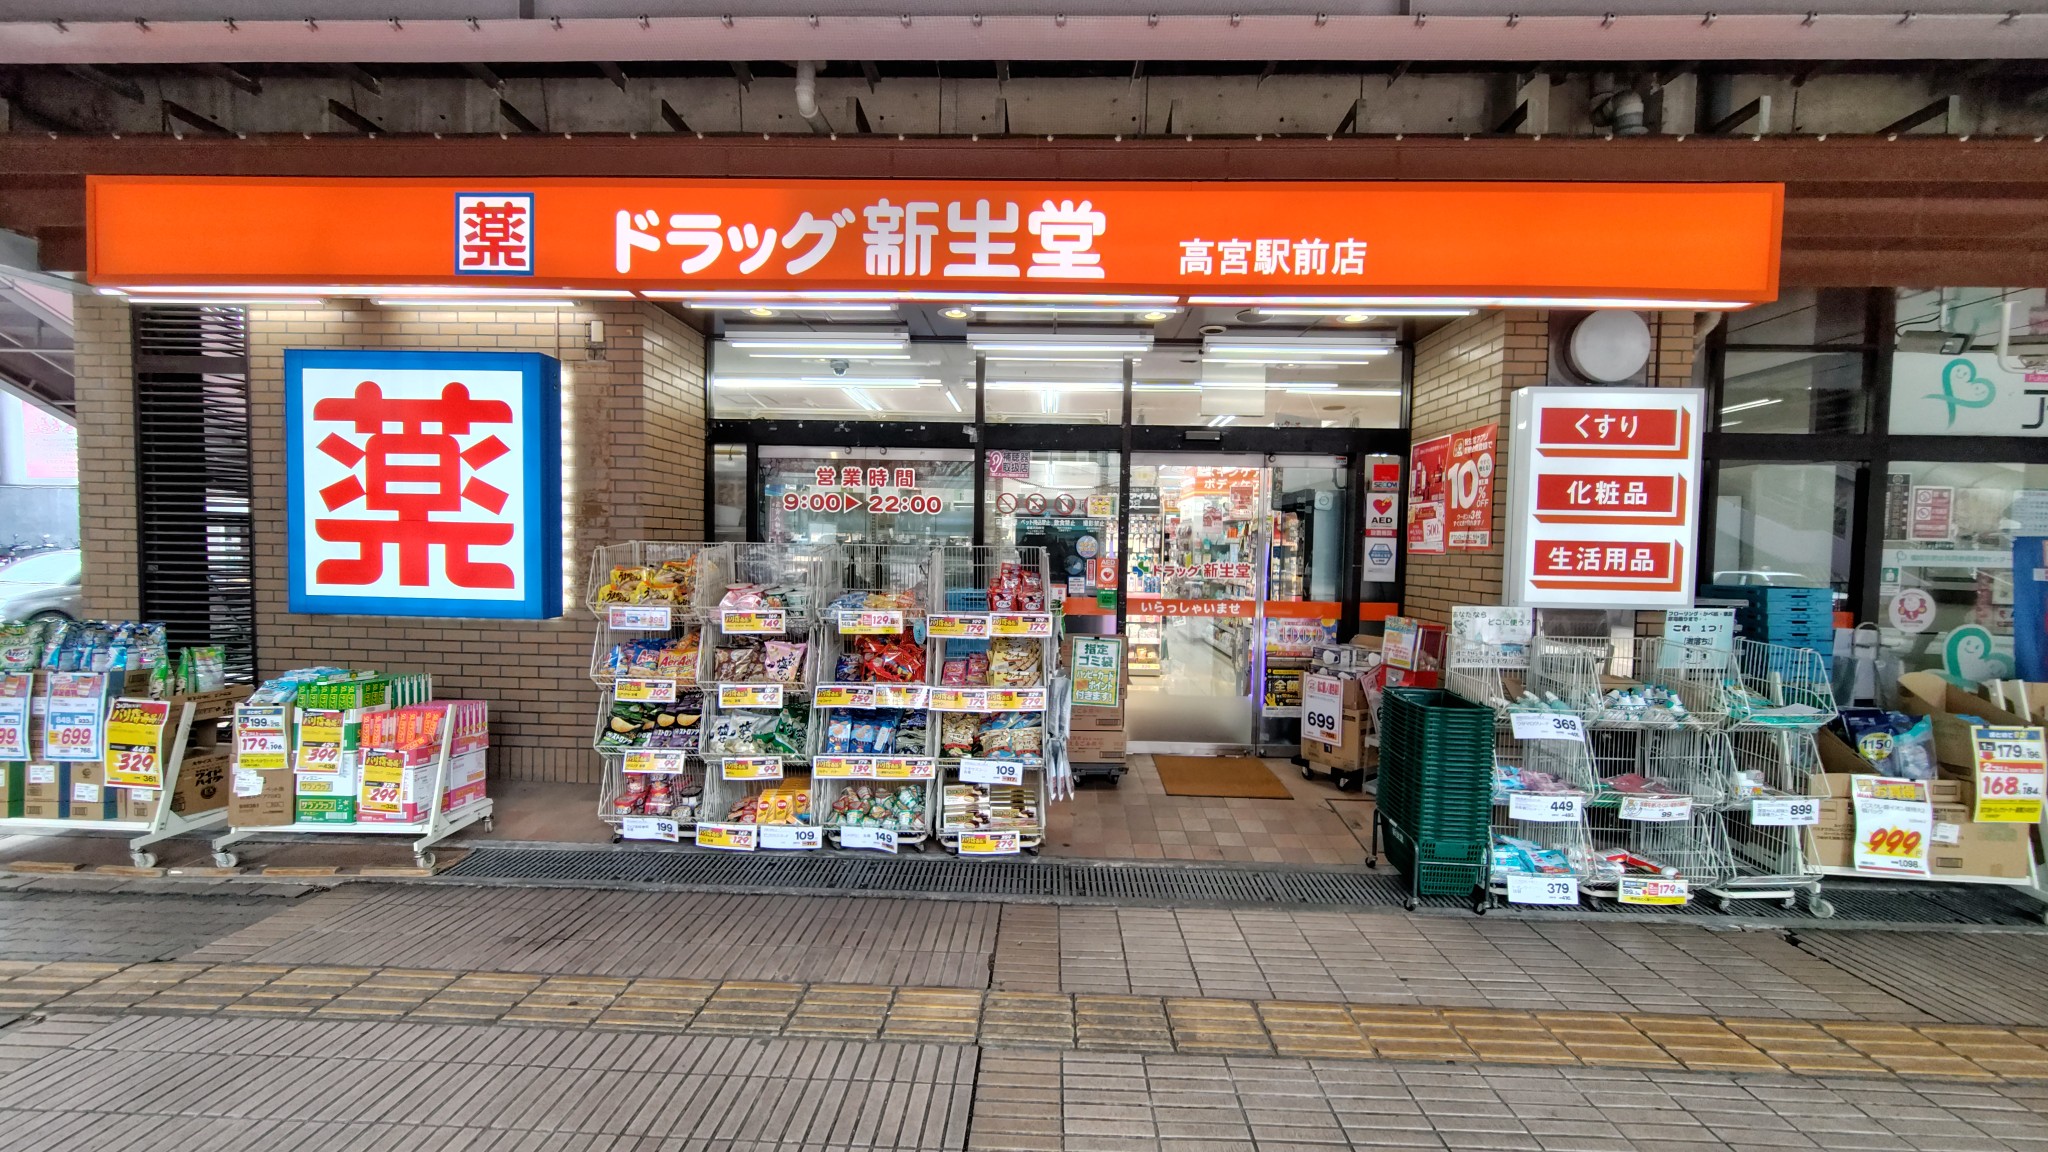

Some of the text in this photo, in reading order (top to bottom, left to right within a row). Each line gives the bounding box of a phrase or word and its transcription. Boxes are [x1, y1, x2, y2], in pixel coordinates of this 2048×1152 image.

[463, 201, 526, 266] 薬
[1179, 237, 1367, 276] 高宮駅前店
[1574, 414, 1638, 439] くすり
[1003, 451, 1029, 462] 補聴器
[1003, 462, 1029, 473] 取扱店
[815, 466, 915, 487] 営業時間
[313, 381, 515, 589] 薬
[1448, 459, 1479, 509] 10
[1567, 480, 1648, 505] 化粧品
[783, 493, 942, 514] 9:00 22:00
[1476, 499, 1489, 508] OFF
[1548, 546, 1654, 572] 生活用品
[1141, 601, 1240, 615] いらっしゃいませ
[762, 619, 779, 628] 149
[873, 615, 889, 625] 129
[966, 625, 983, 633] 179
[1084, 643, 1109, 655] 指定
[1079, 655, 1113, 667] ゴミ袋
[1076, 670, 1114, 680] ハッピーカード
[1088, 680, 1113, 690] ポイント
[851, 695, 869, 703] 259
[1022, 698, 1040, 706] 279
[250, 718, 267, 727] 199
[1307, 711, 1335, 730] 699
[1552, 718, 1577, 731] 369
[61, 728, 91, 745] 699
[242, 738, 268, 750] 179
[1862, 739, 1891, 749] 1150
[308, 749, 337, 761] 399
[1998, 744, 2022, 758] 179
[119, 753, 154, 771] 329
[763, 765, 777, 773] 99
[852, 765, 869, 773] 139
[910, 766, 928, 774] 279
[996, 766, 1015, 776] 109
[1983, 776, 2019, 795] 168
[370, 788, 398, 801] 299
[301, 801, 335, 809] サランラップ
[1551, 801, 1573, 811] 449
[1790, 804, 1812, 815] 899
[656, 822, 673, 832] 199
[732, 836, 749, 844] 129
[795, 831, 815, 840] 109
[875, 832, 892, 843] 149
[1869, 828, 1922, 854] 999
[1547, 883, 1569, 894] 379
[1659, 884, 1676, 894] 179
